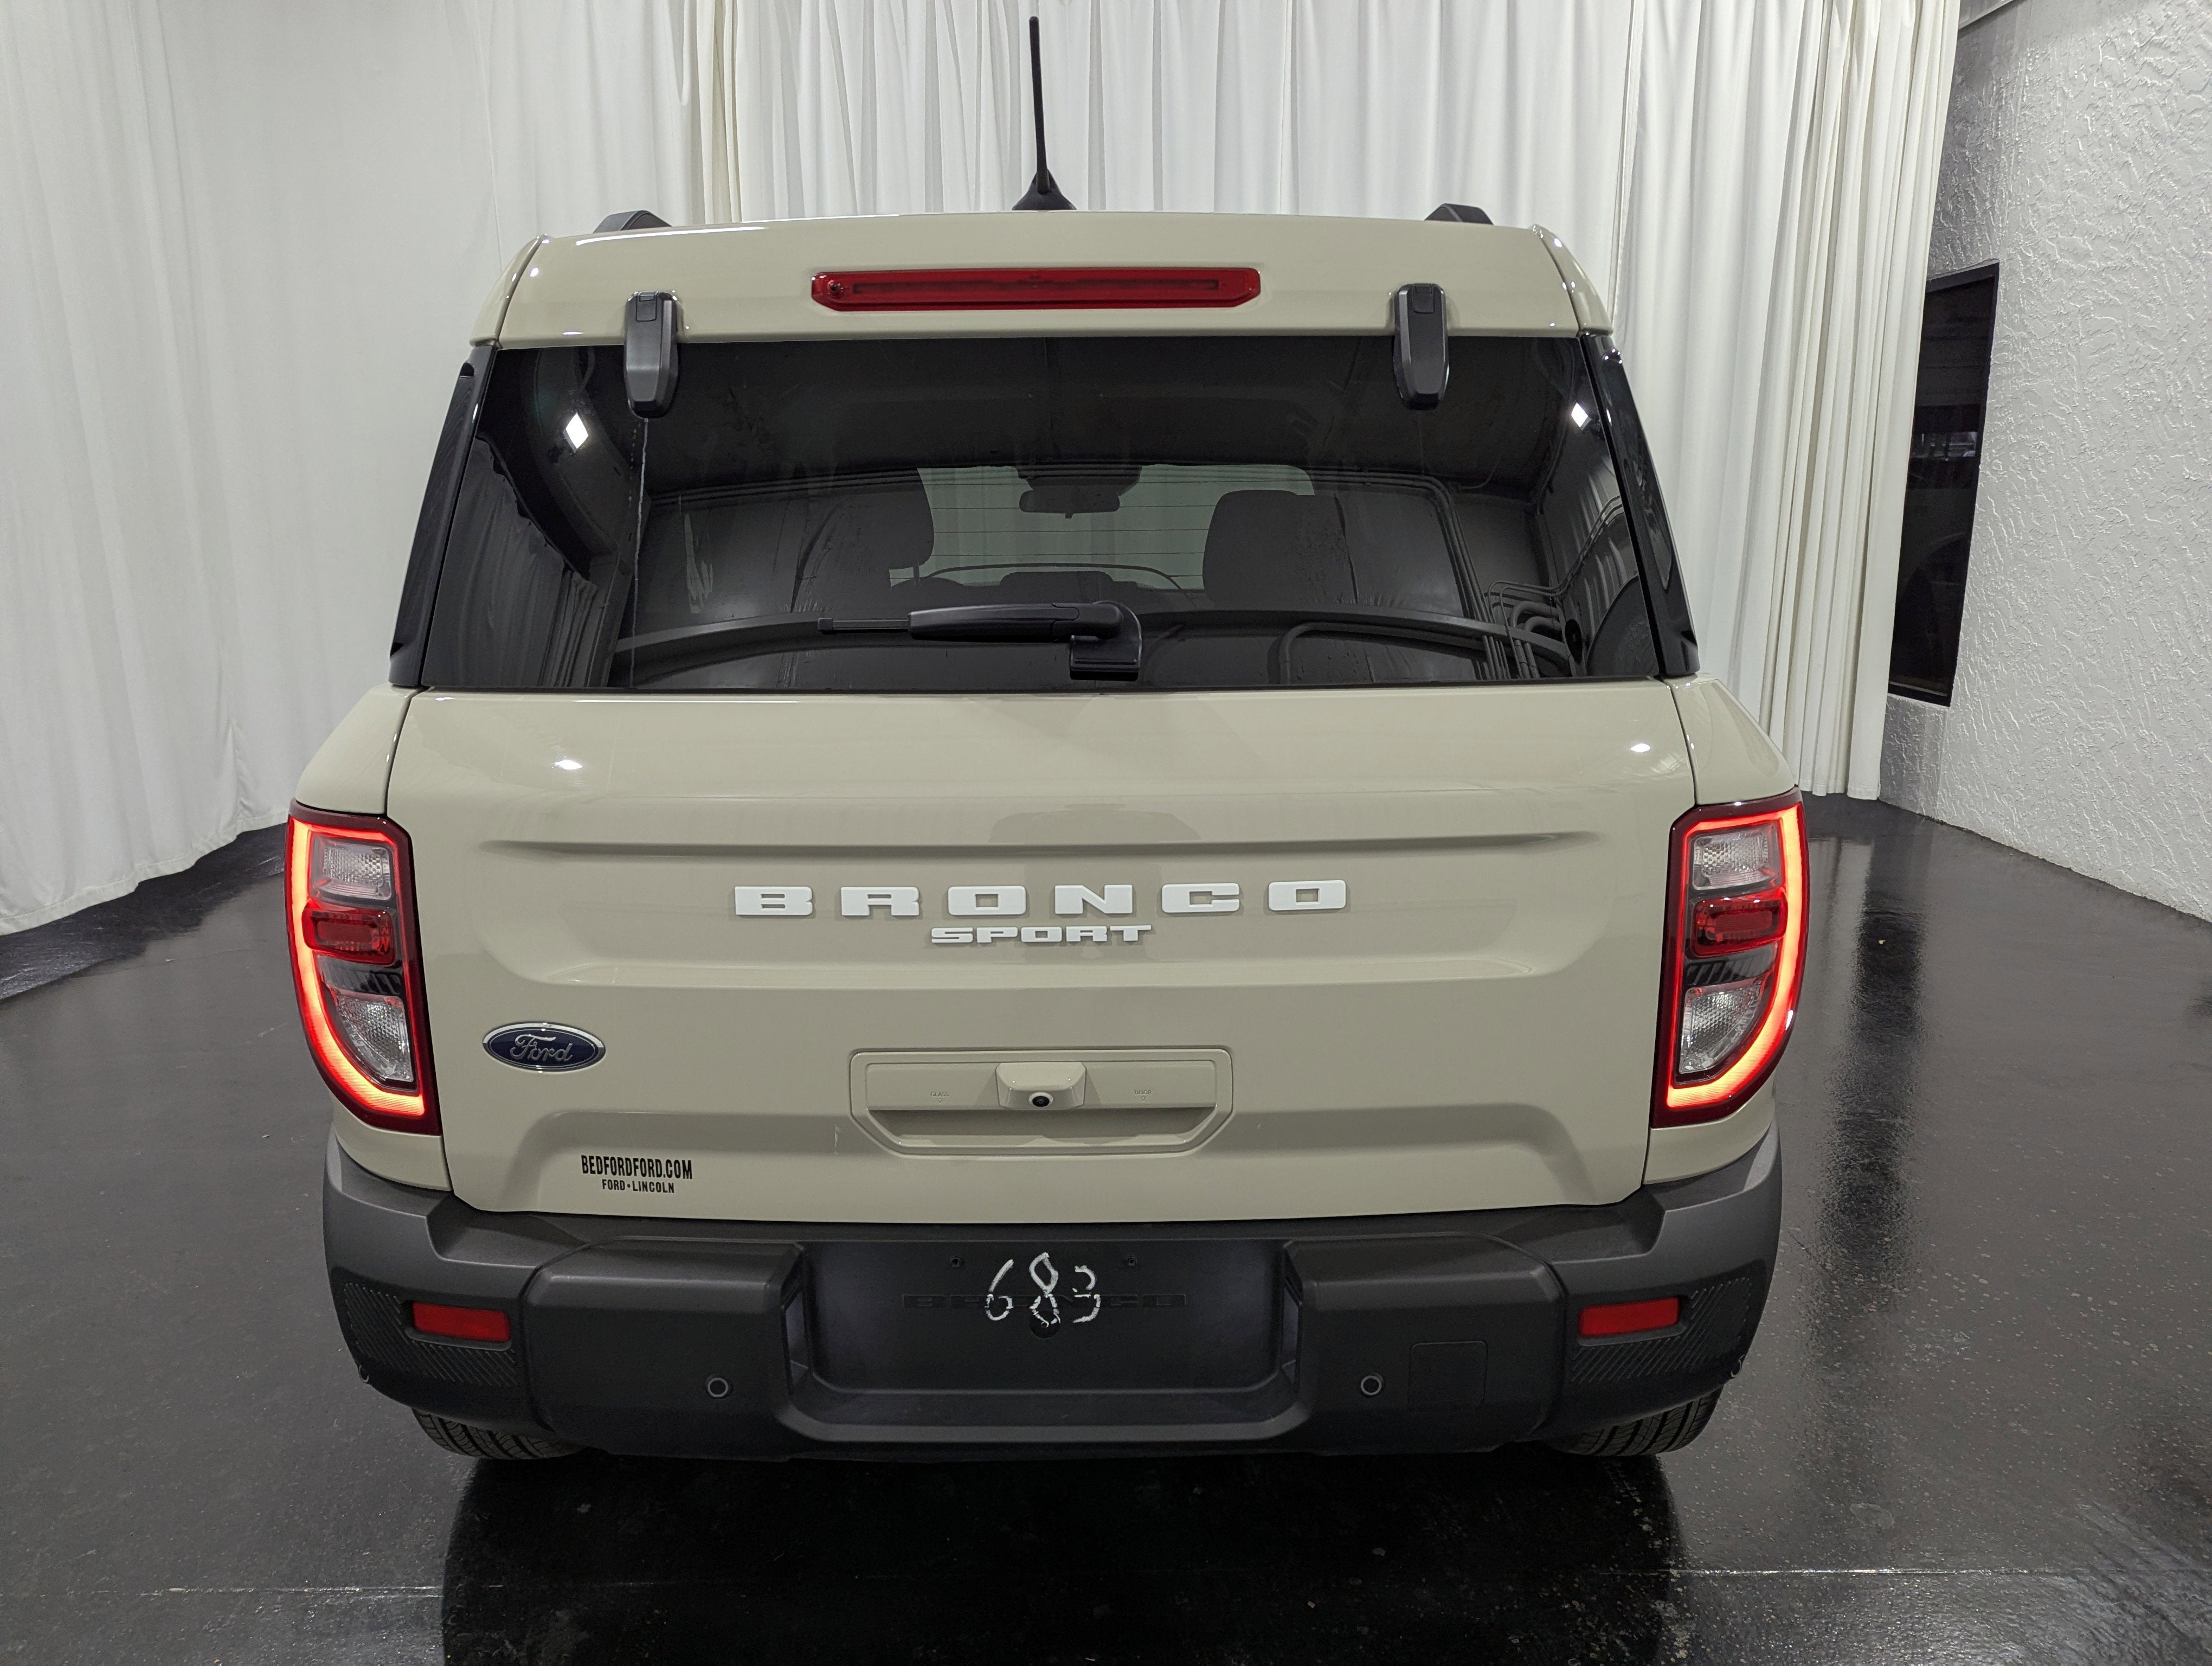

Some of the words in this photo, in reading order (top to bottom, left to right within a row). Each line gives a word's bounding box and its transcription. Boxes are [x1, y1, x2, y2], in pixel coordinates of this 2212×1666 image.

[734, 880, 1347, 917] BRONCO
[931, 925, 1152, 943] SPORT
[510, 1034, 573, 1062] Ford
[581, 1155, 692, 1180] BEDFORDFORD.COM
[984, 1252, 1101, 1328] 683
